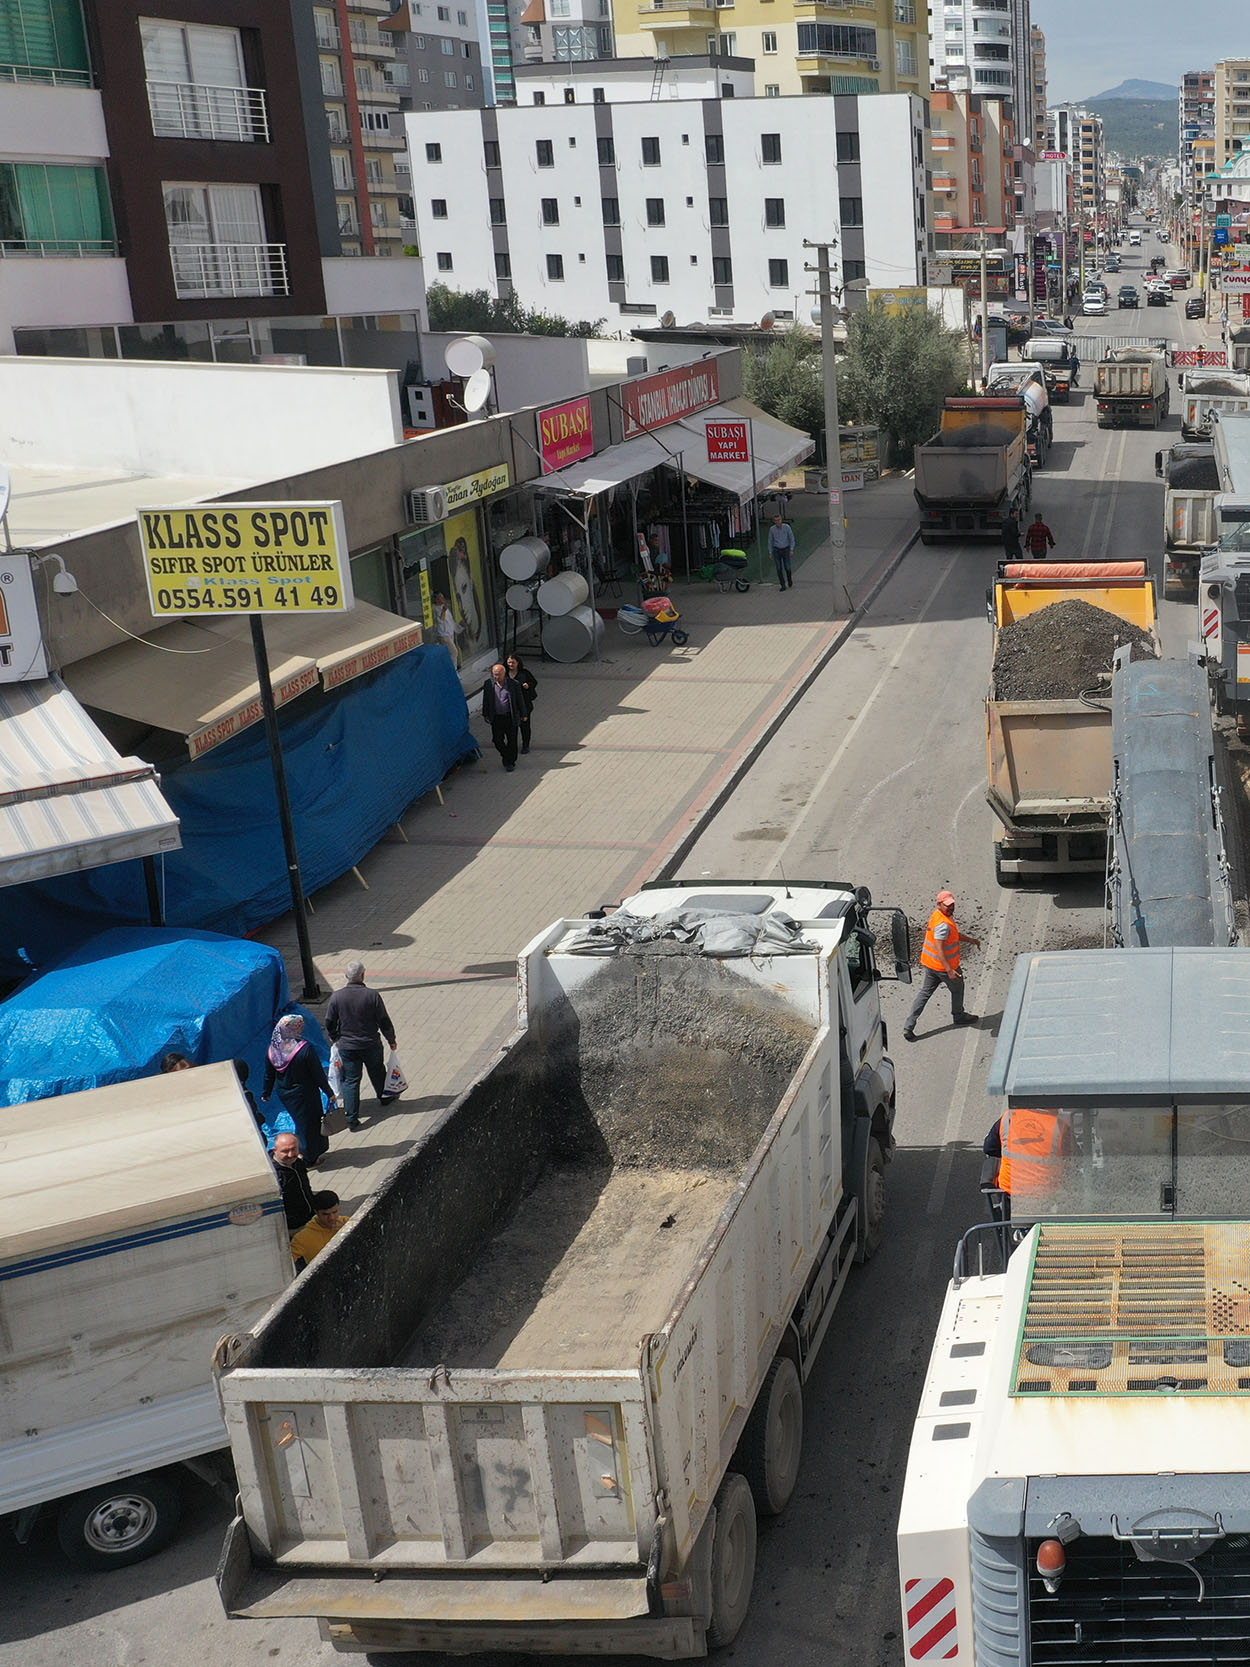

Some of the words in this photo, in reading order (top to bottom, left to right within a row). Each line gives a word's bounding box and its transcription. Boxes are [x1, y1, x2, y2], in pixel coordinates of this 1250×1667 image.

[542, 405, 589, 446] SUBAŞI
[707, 426, 744, 440] SUBAŞI
[710, 452, 746, 460] MARKET
[718, 442, 737, 450] YAPI
[143, 513, 241, 549] KLASS
[251, 511, 328, 548] SPOT
[151, 557, 198, 574] SIFIR
[203, 556, 246, 573] SPOT
[251, 551, 334, 573] ÜRÜNLER
[204, 577, 261, 586] Klass
[267, 576, 313, 586] Spot
[158, 587, 264, 609] 0554.591
[274, 586, 301, 607] 41
[310, 585, 338, 606] 49
[281, 679, 300, 701] KLASS
[300, 670, 316, 690] SPOT
[195, 729, 217, 754] KLASS
[217, 718, 235, 742] SPOT
